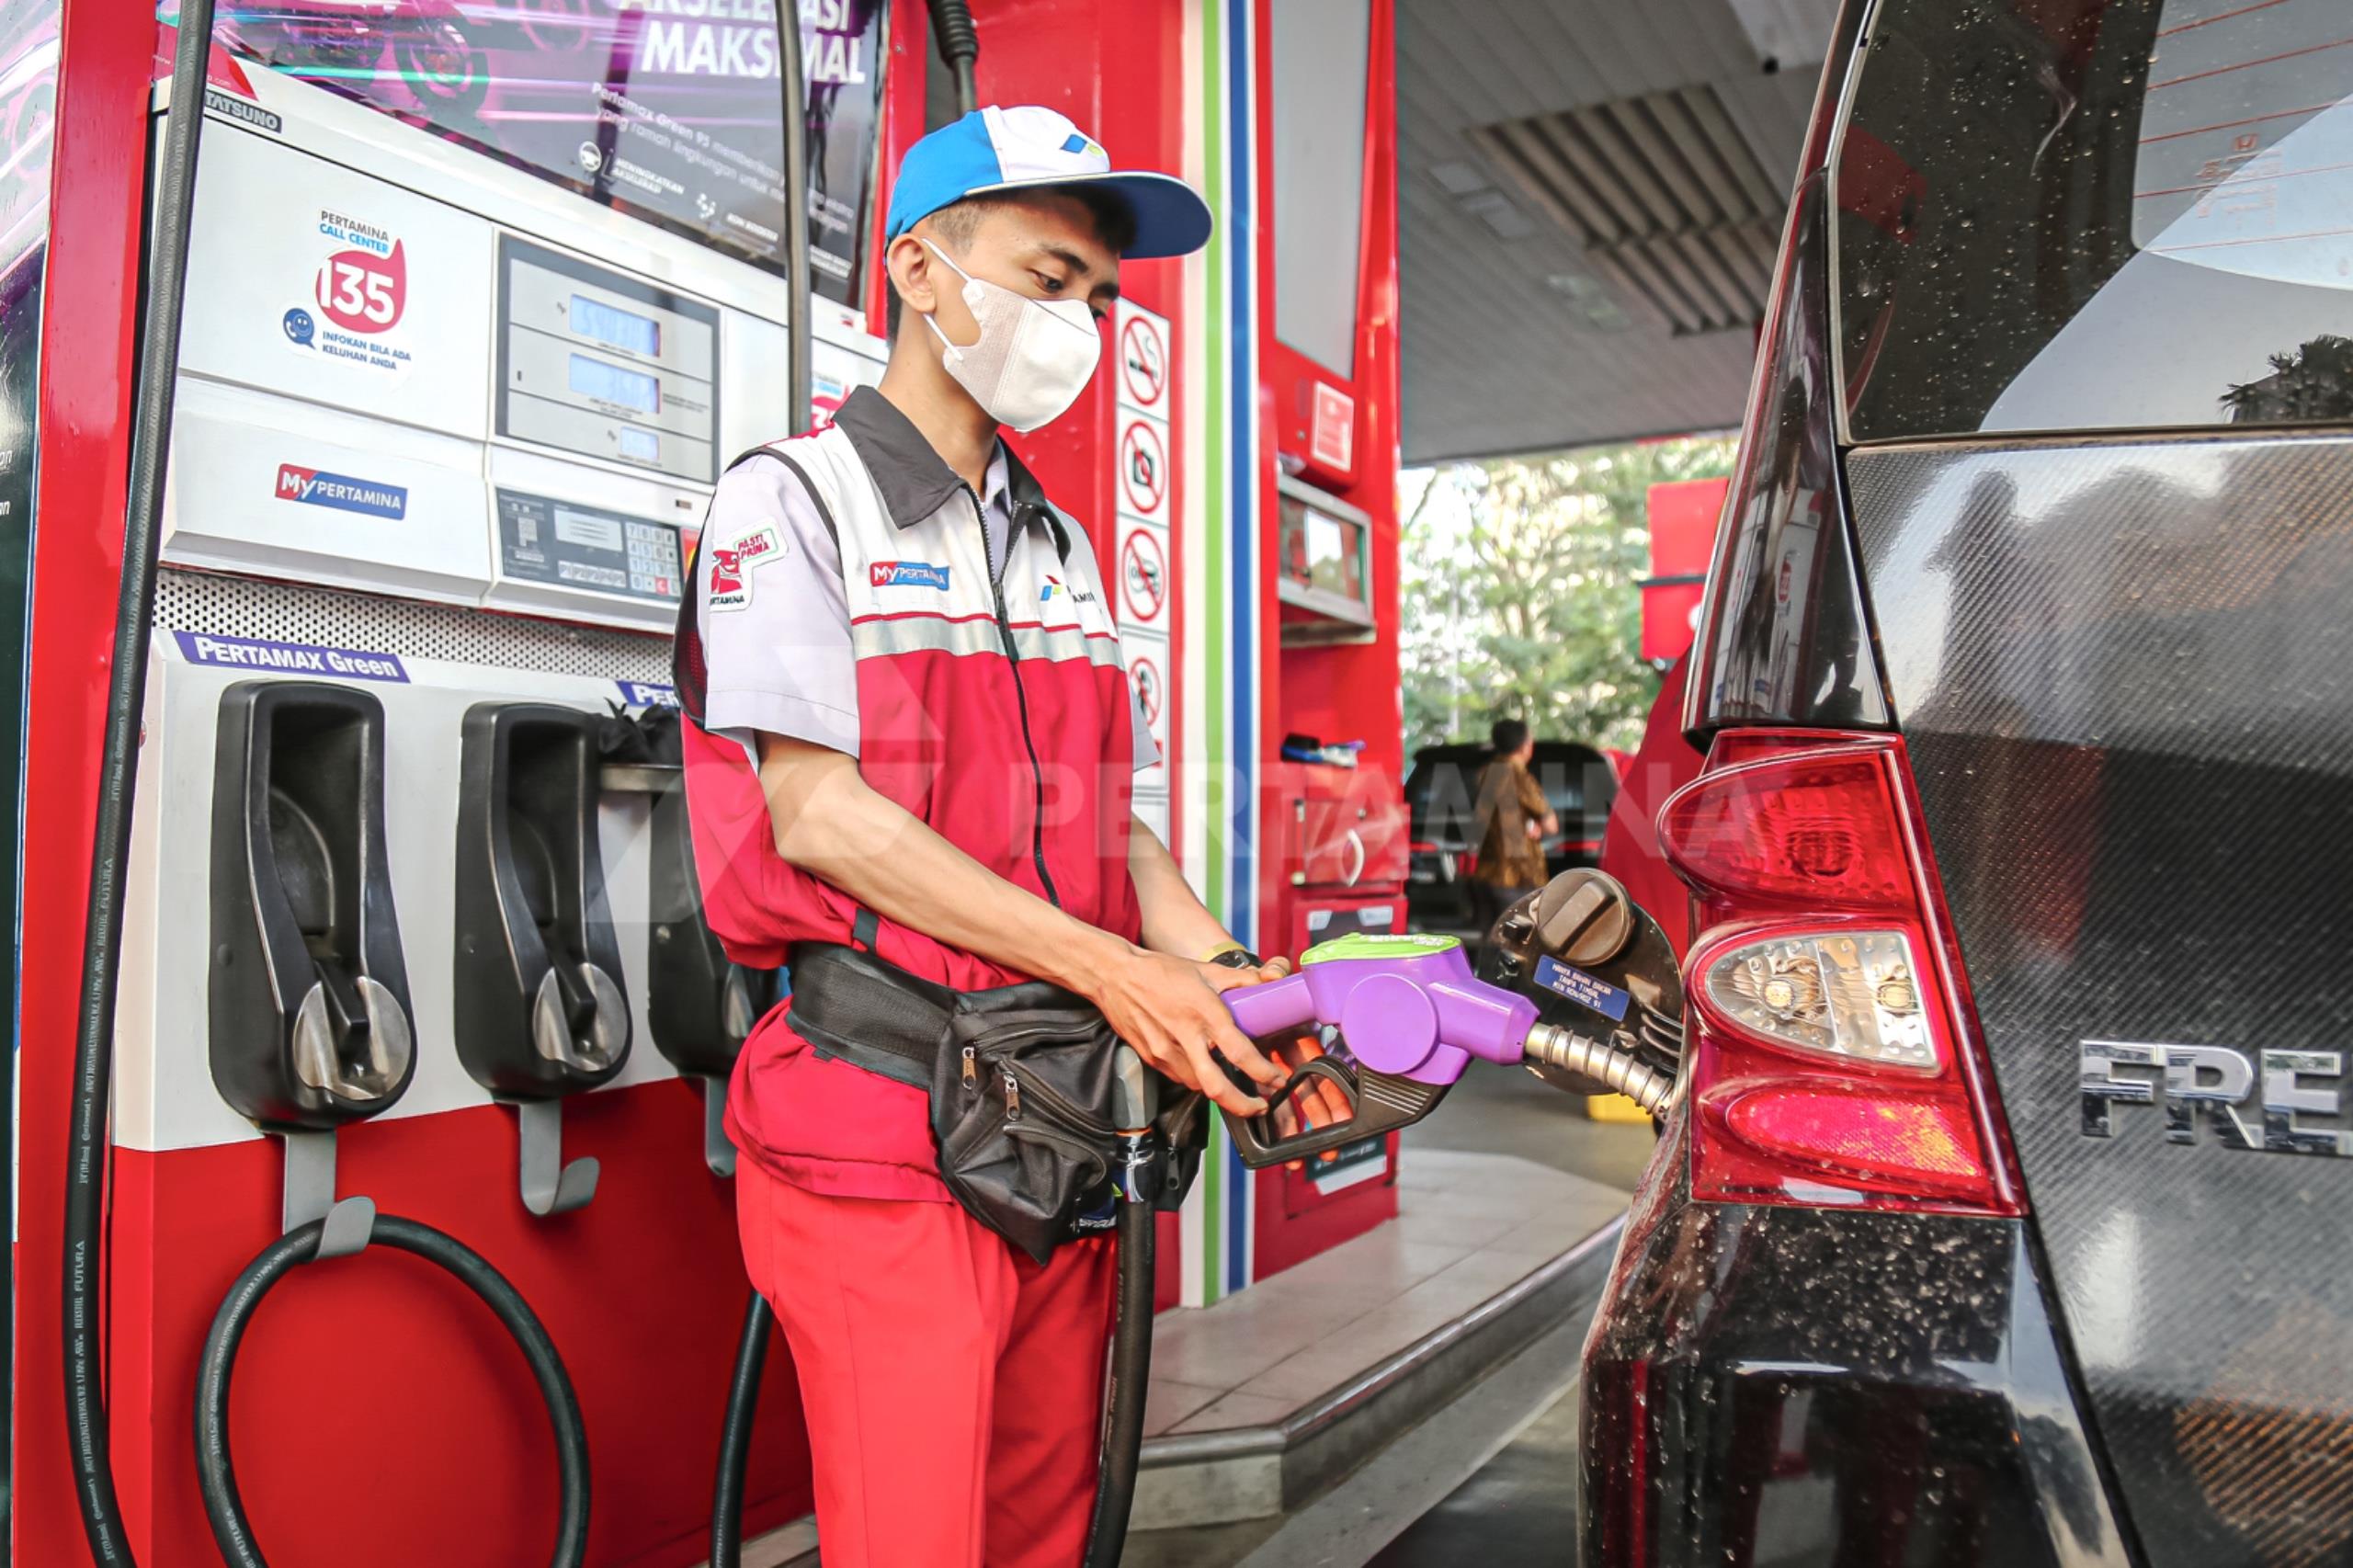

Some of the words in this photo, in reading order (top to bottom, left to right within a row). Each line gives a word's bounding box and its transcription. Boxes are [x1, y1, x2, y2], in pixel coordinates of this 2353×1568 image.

[205, 92, 278, 129] TATSUNO
[320, 223, 346, 241] CALL
[349, 233, 389, 254] CENTER
[321, 210, 389, 242] PERTAMINA
[320, 257, 395, 324] 135
[323, 331, 367, 350] INFOKAN
[370, 343, 391, 357] BILA
[392, 348, 412, 361] ADA
[323, 344, 368, 363] KELUHAN
[370, 356, 397, 370] ANDA
[738, 534, 764, 551] PASTI
[740, 542, 770, 560] PRIMA
[874, 566, 946, 585] MyPERTAA
[710, 596, 745, 606] RTAMINA
[194, 636, 325, 672] PERTAMAX
[327, 651, 399, 677] Green
[2079, 1040, 2353, 1153] FRE
[74, 1240, 85, 1292] FUTURA
